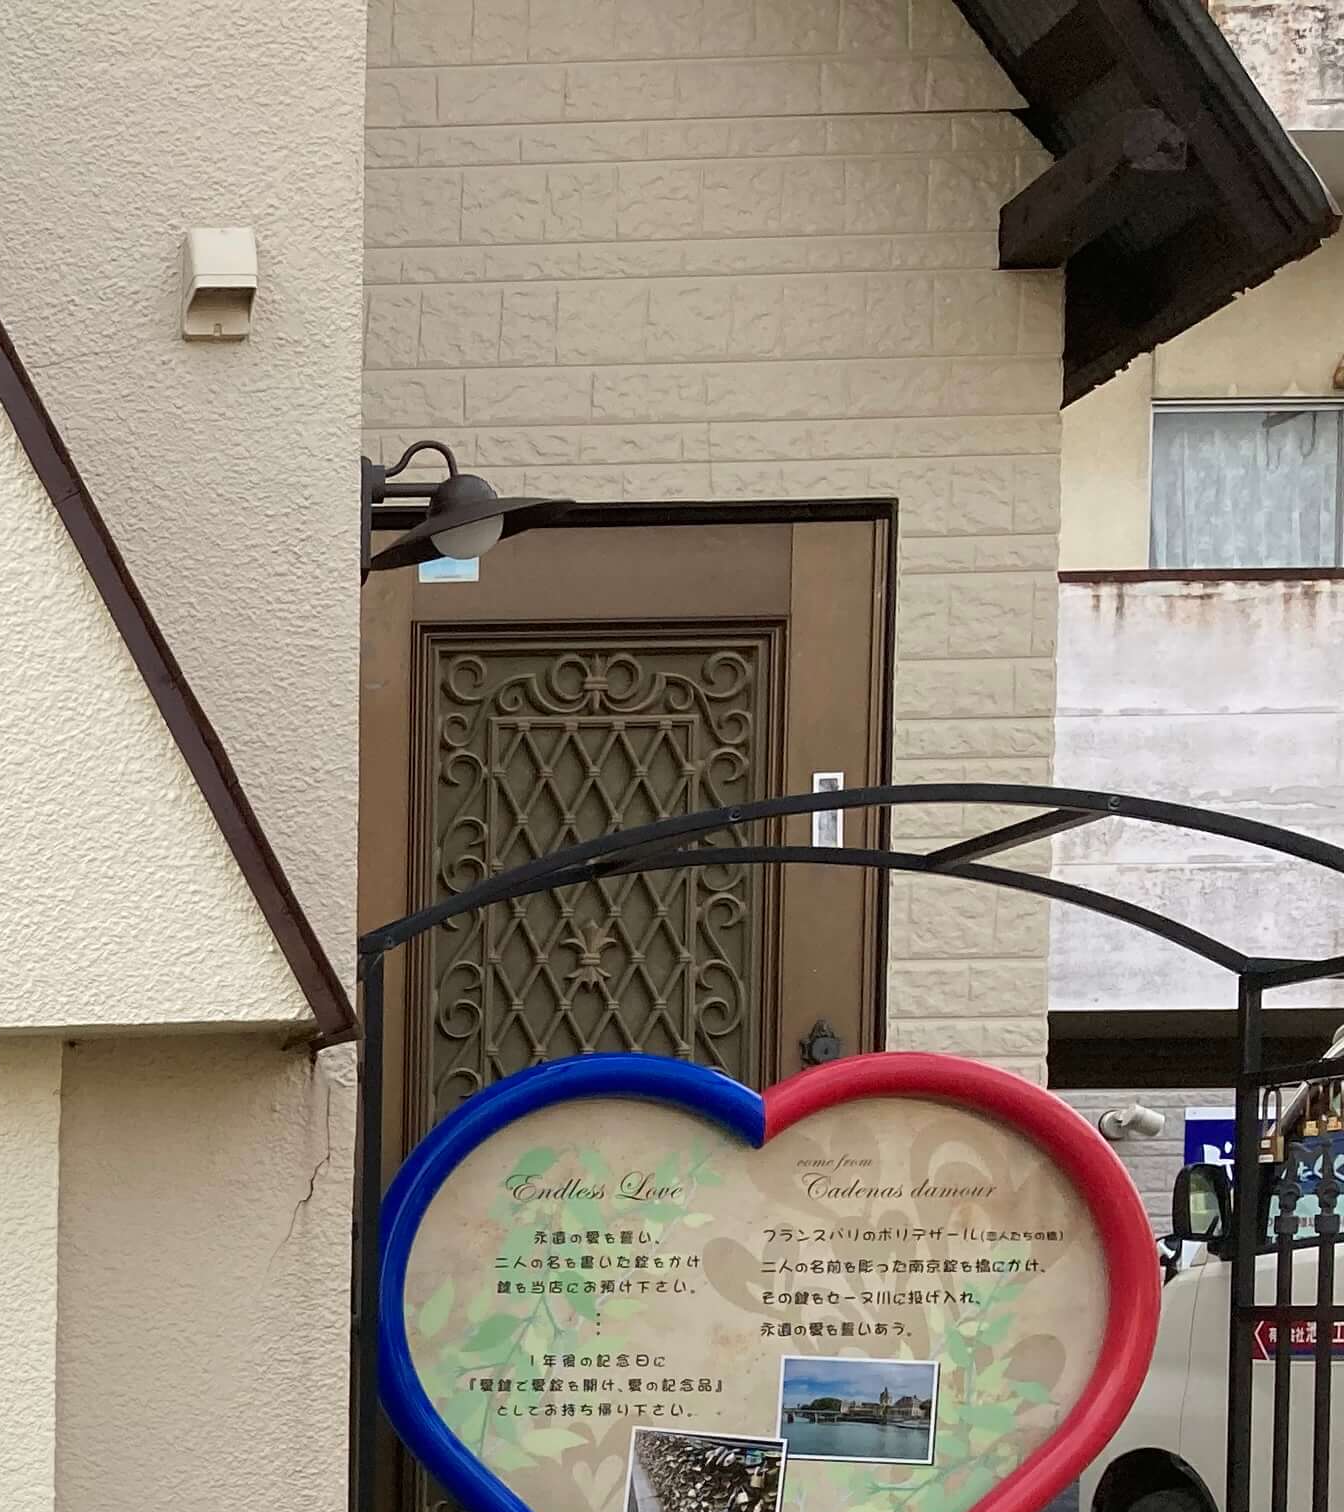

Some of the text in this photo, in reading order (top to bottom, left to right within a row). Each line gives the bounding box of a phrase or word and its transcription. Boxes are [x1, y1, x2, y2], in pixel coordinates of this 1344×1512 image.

[505, 1170, 685, 1202] Endless Love
[910, 1178, 998, 1199] damour
